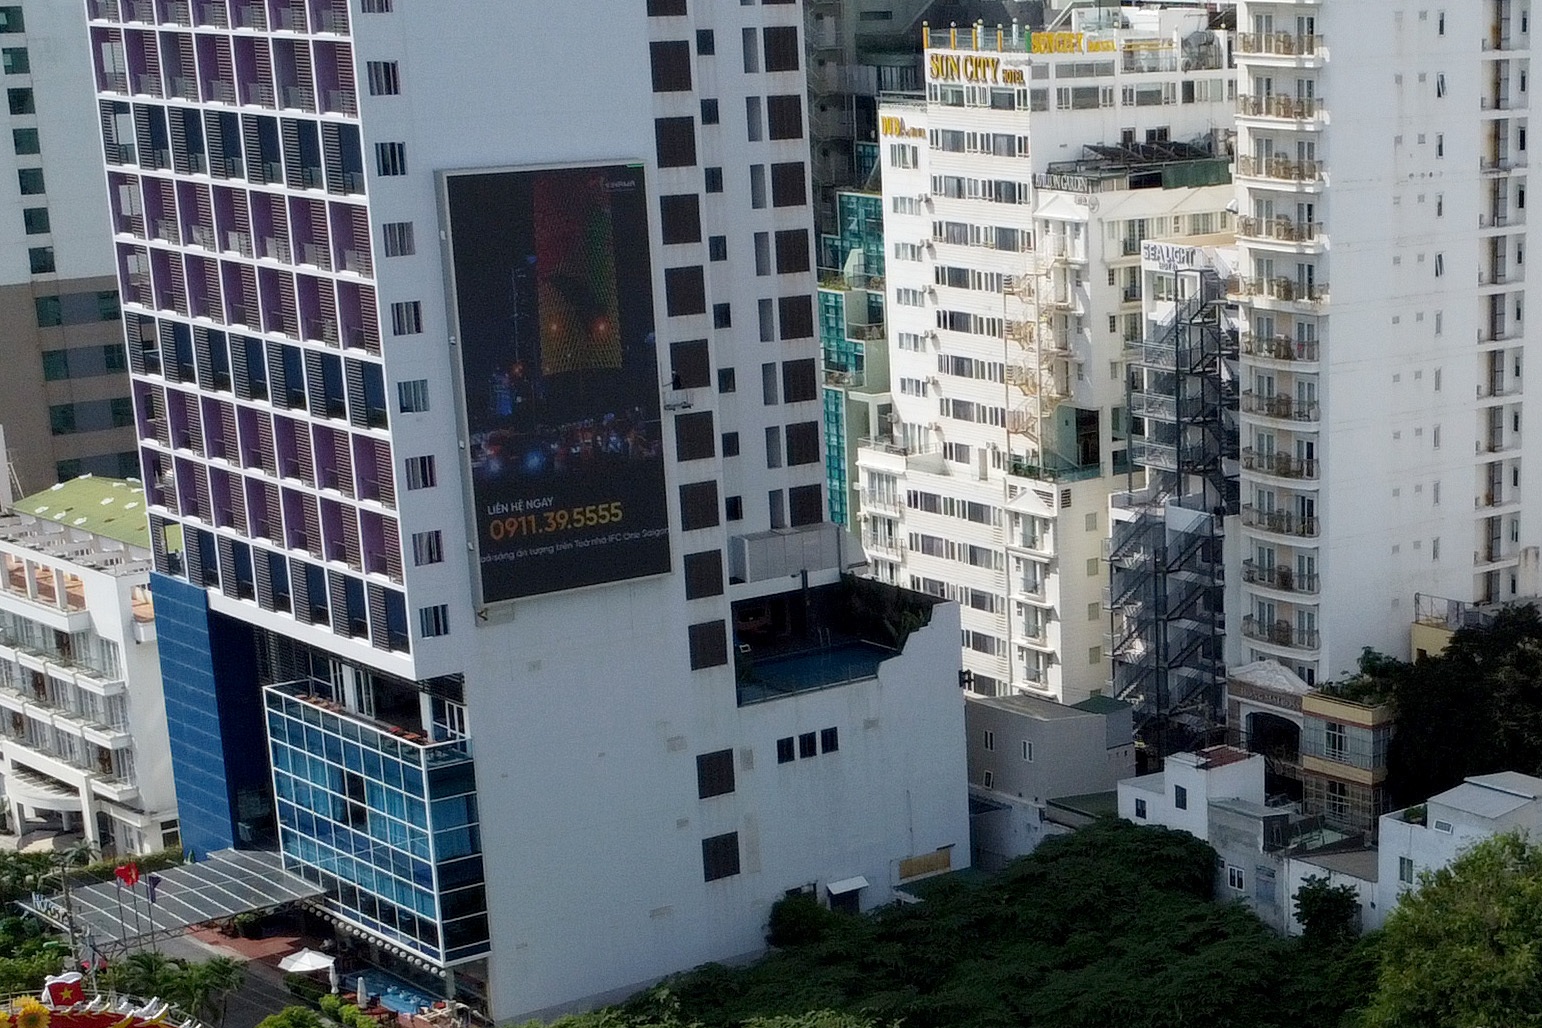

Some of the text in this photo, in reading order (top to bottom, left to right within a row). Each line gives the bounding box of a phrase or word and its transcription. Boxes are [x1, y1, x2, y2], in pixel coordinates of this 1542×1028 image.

[929, 53, 1026, 85] SUN CITY HOTEL
[526, 497, 554, 509] NGAY
[489, 502, 623, 541] 0911.39.5555
